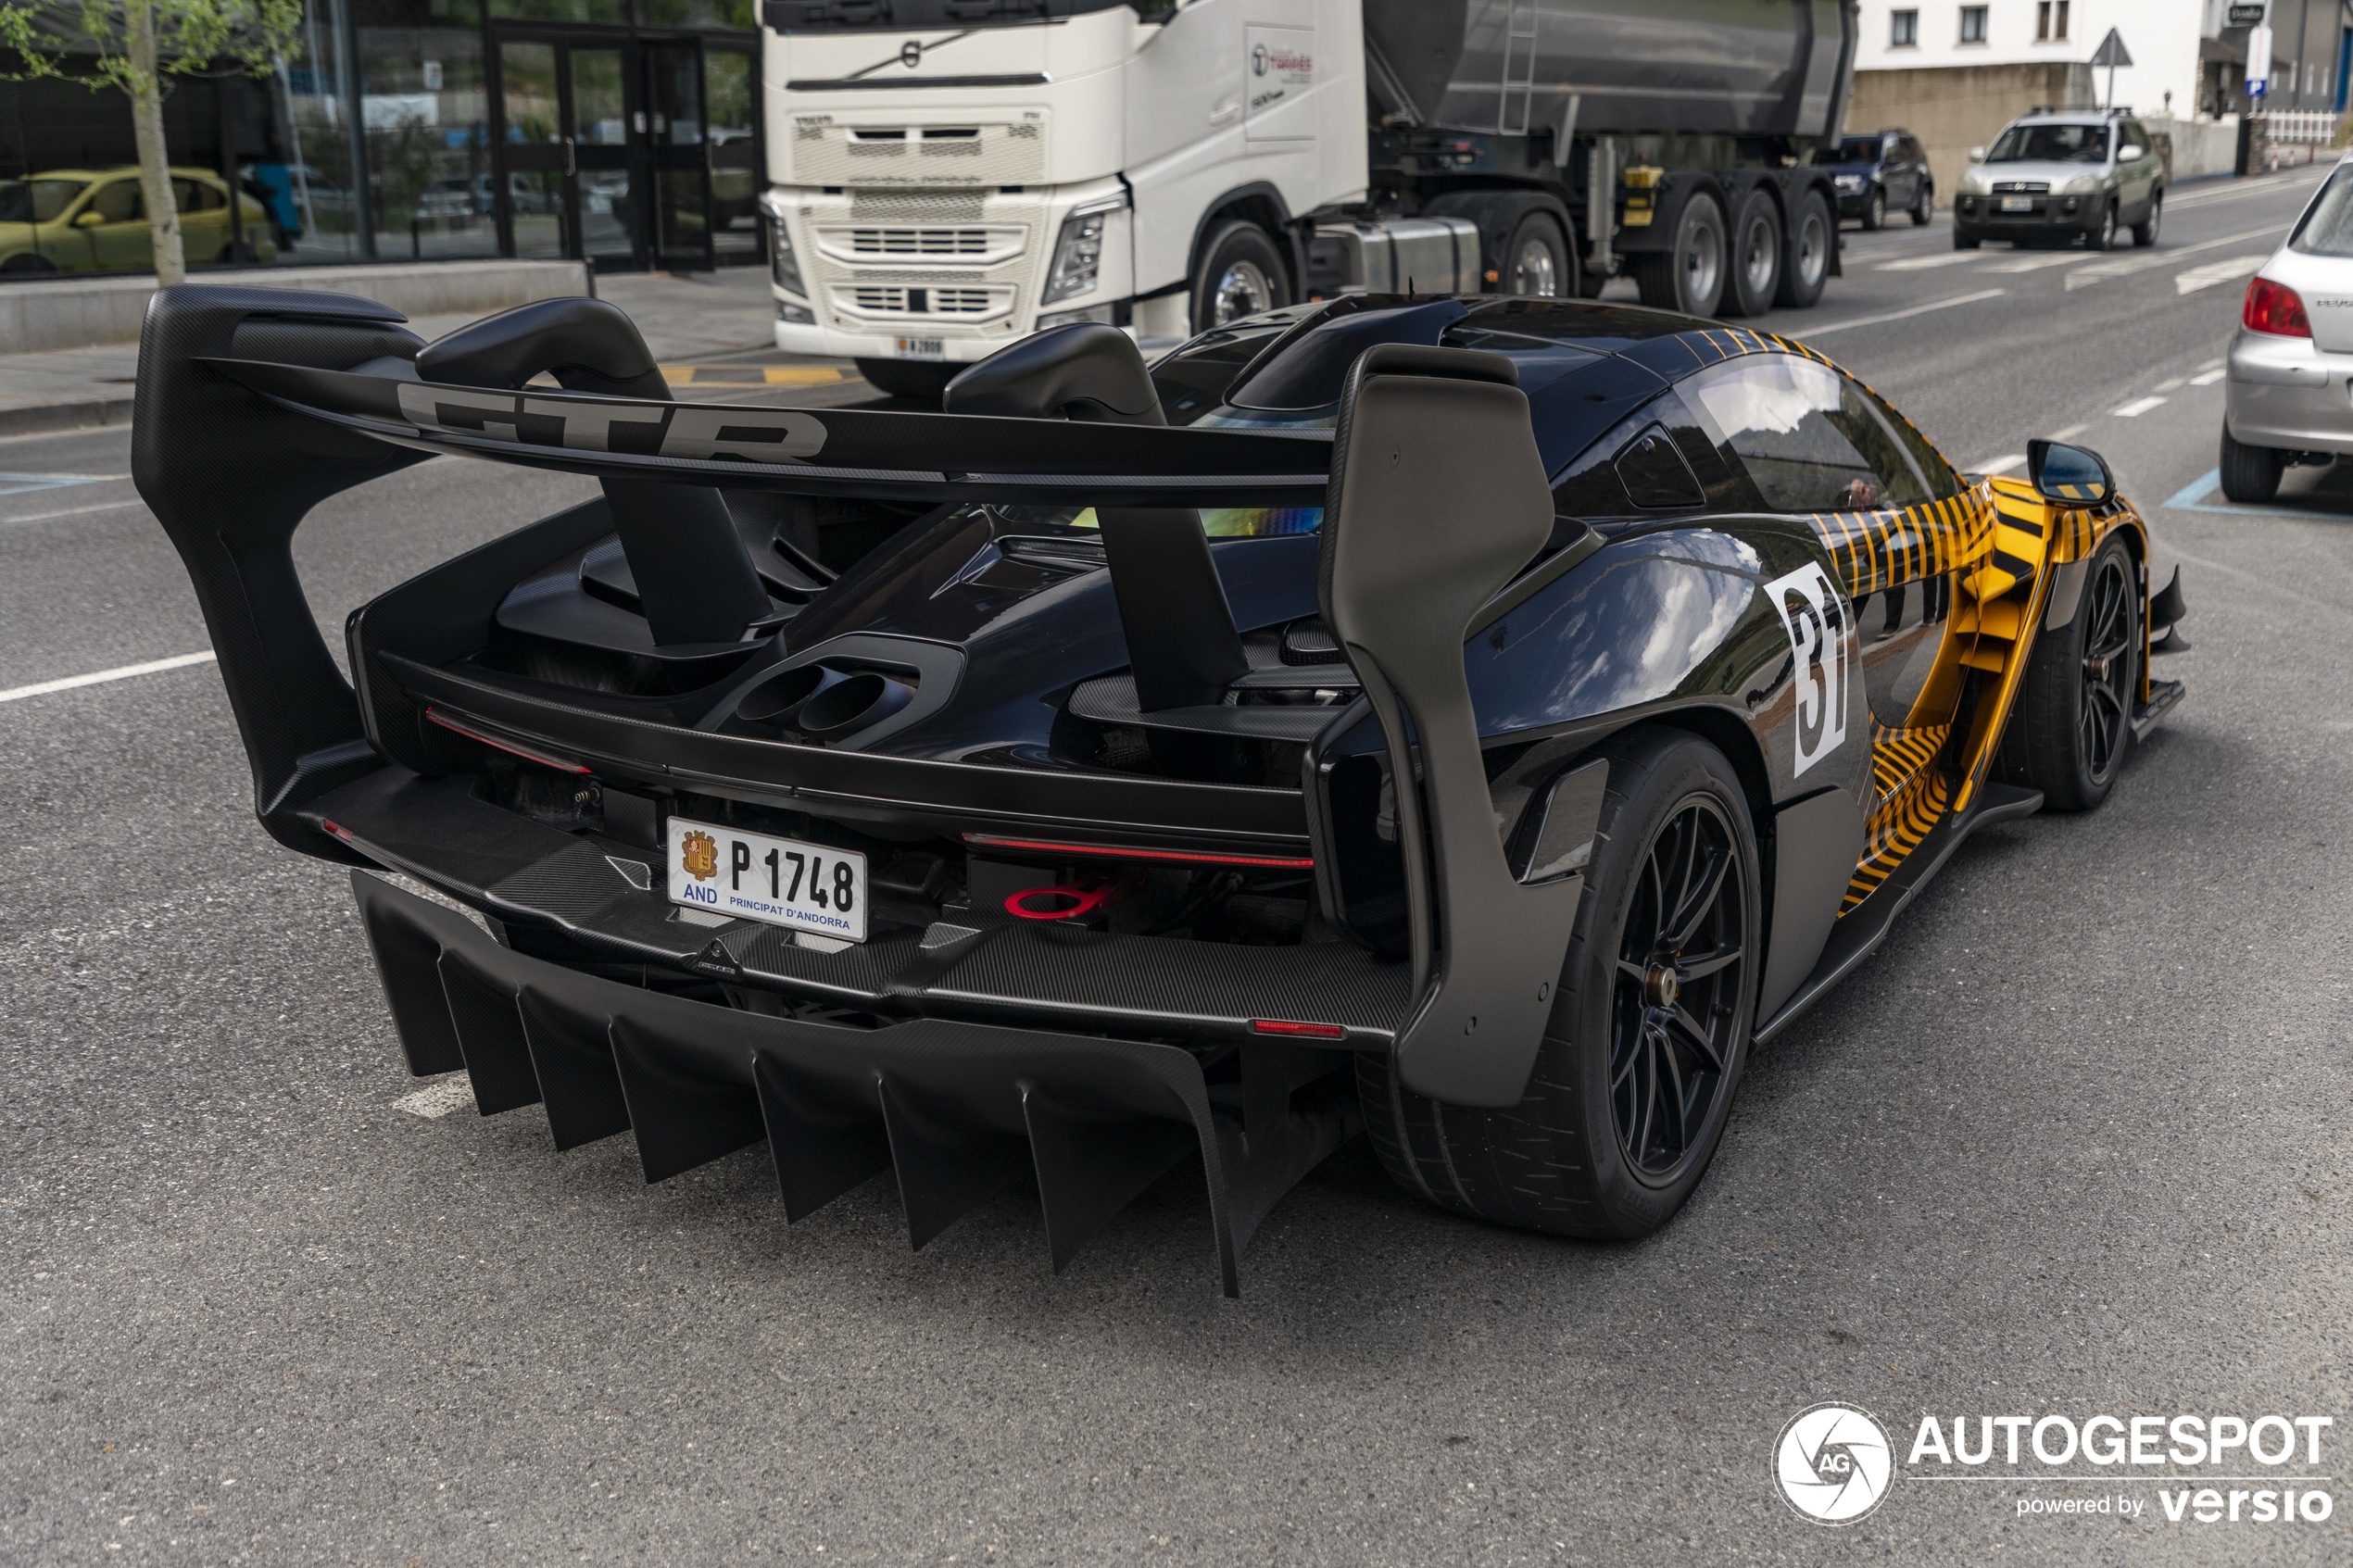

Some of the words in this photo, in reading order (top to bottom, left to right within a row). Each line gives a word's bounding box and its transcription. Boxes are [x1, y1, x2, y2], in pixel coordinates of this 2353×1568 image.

[2248, 81, 2263, 95] P
[396, 383, 828, 466] GTR
[1783, 574, 1844, 758] 31
[684, 884, 718, 905] AND
[732, 840, 750, 891] P
[764, 847, 853, 912] 1748
[729, 896, 784, 916] PRINCIPAT
[786, 908, 850, 930] D'ANDORRA
